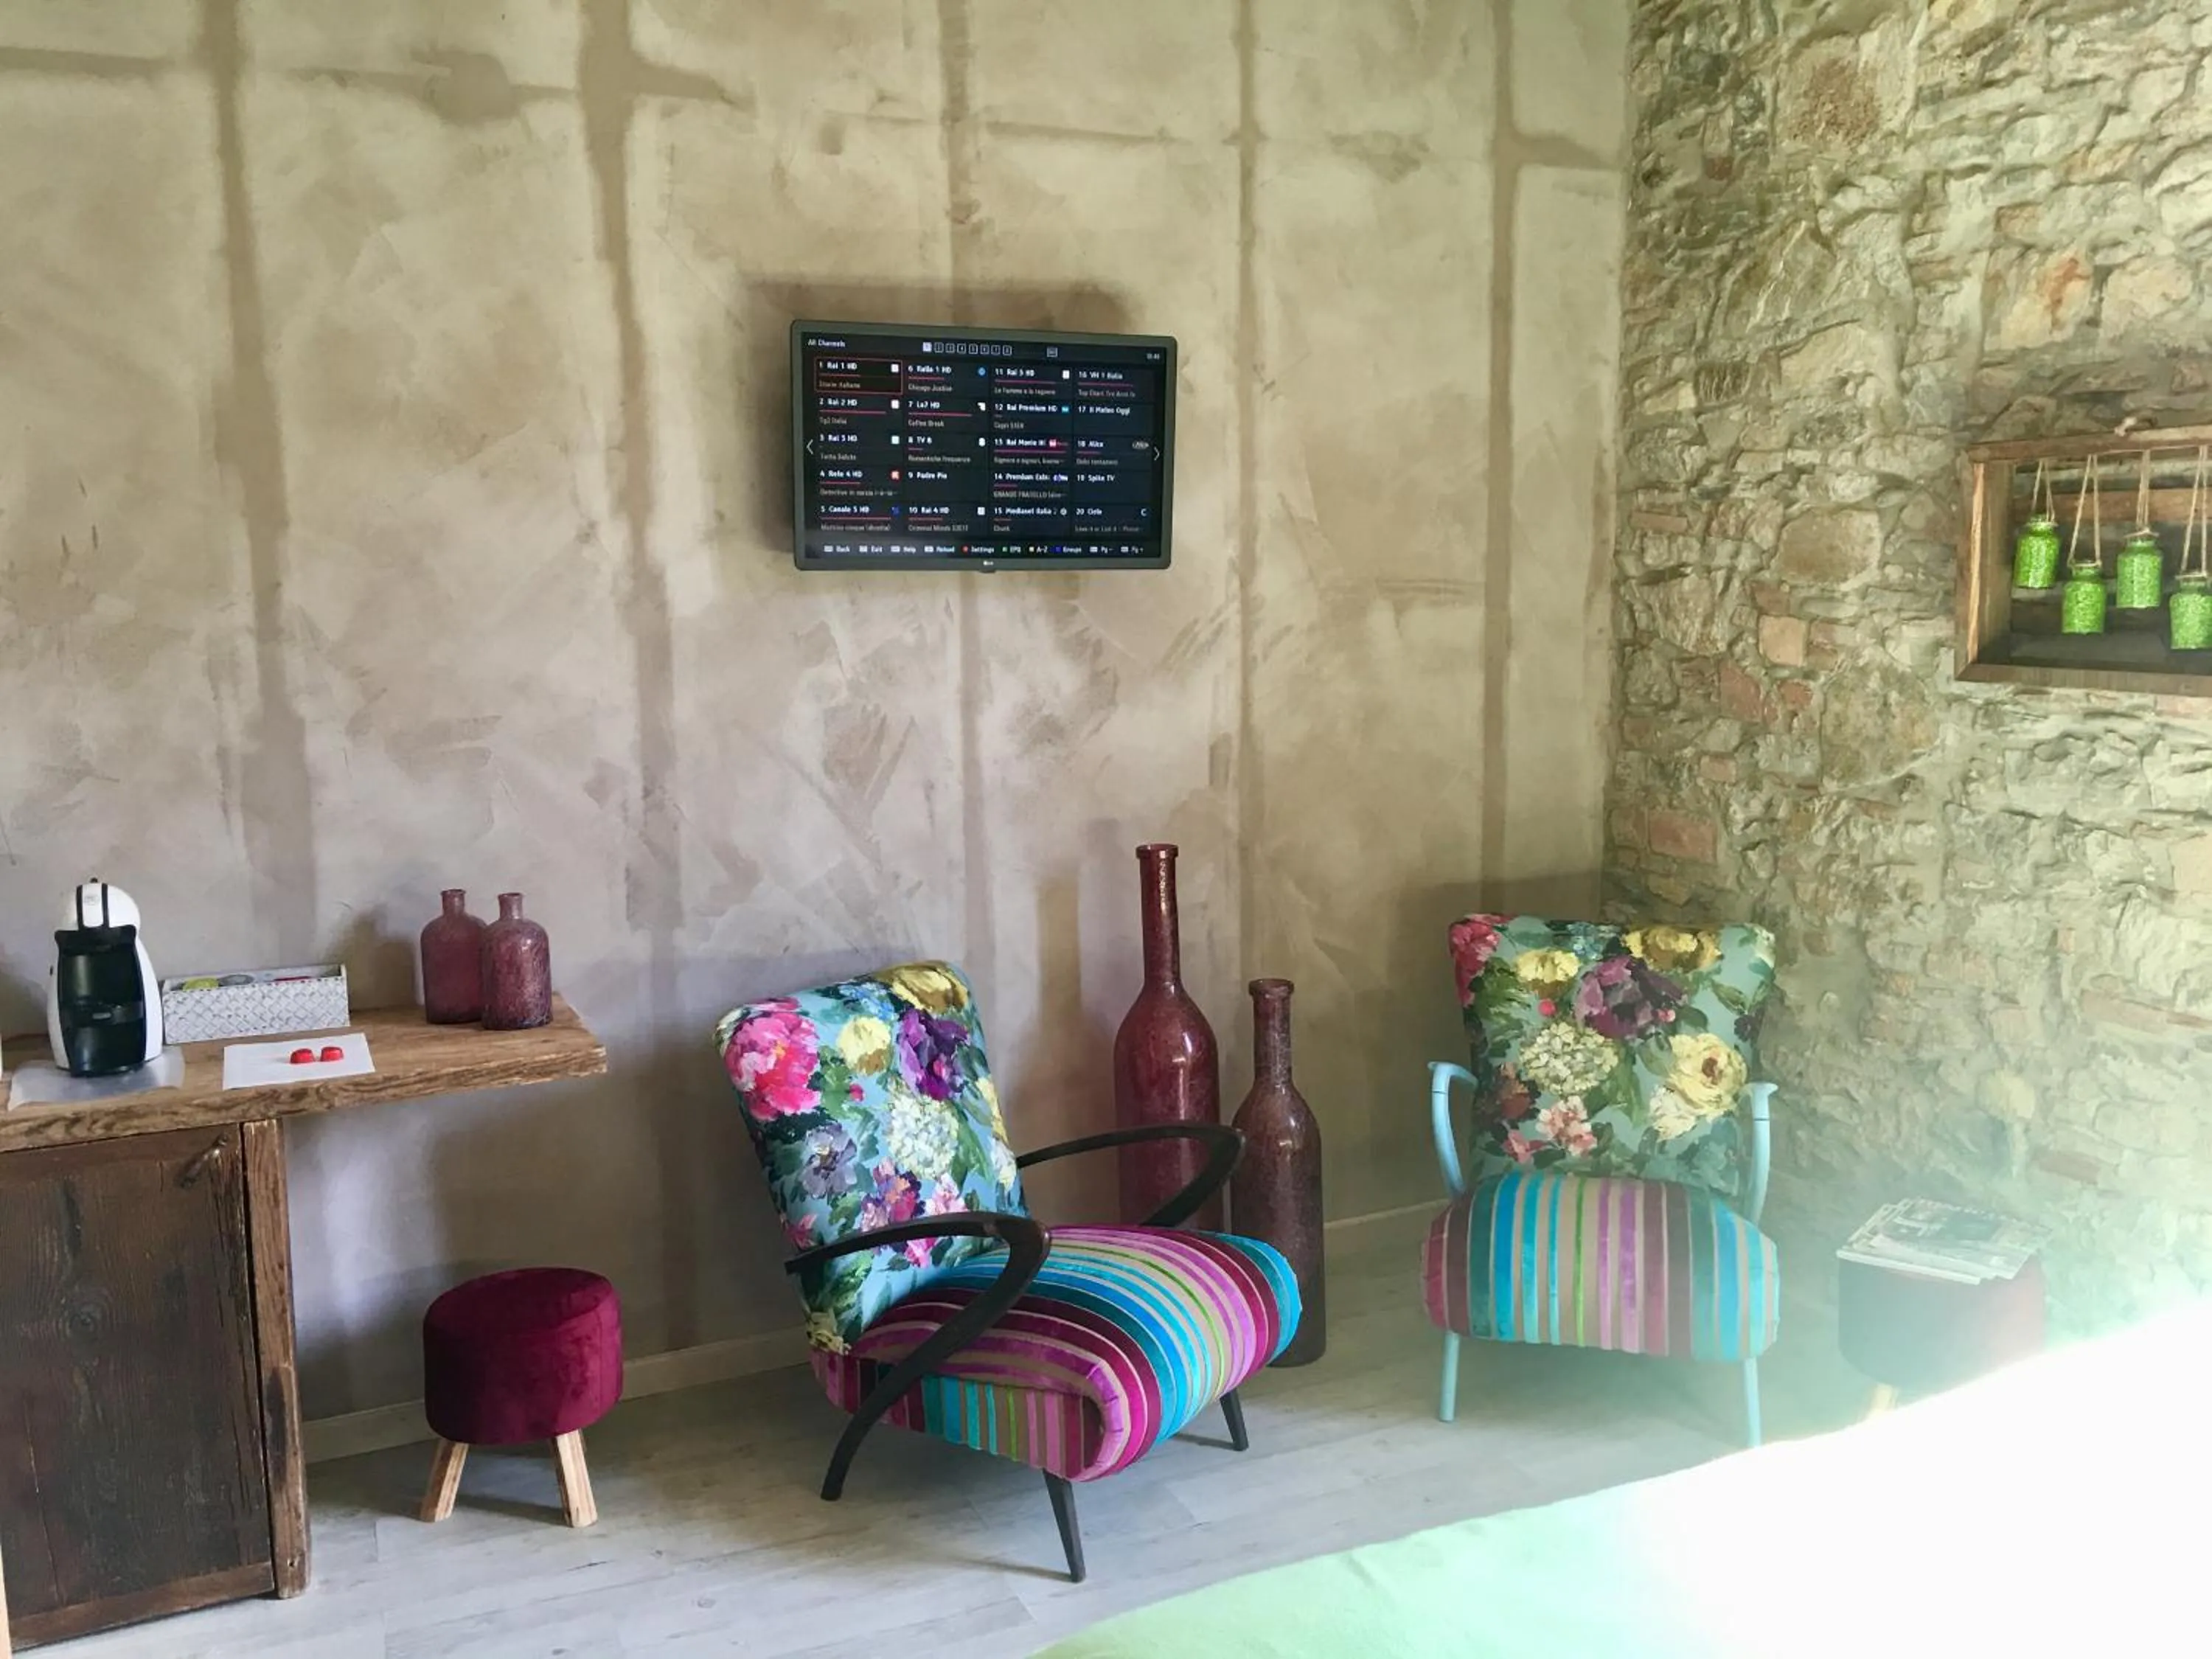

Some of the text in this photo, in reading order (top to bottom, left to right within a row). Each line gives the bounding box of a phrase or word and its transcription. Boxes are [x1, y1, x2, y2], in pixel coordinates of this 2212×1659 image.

[827, 361, 838, 369] Rai
[847, 362, 858, 370] HD
[1006, 368, 1018, 376] Rai
[827, 398, 839, 406] Rai
[841, 398, 846, 406] 2
[1116, 406, 1130, 416] Oggi
[828, 434, 840, 442] Rai
[847, 434, 858, 442] HD
[917, 436, 925, 444] TV
[828, 470, 844, 478] Rete
[846, 470, 851, 478] 4
[828, 505, 852, 513] Canale
[970, 546, 995, 554] Settings
